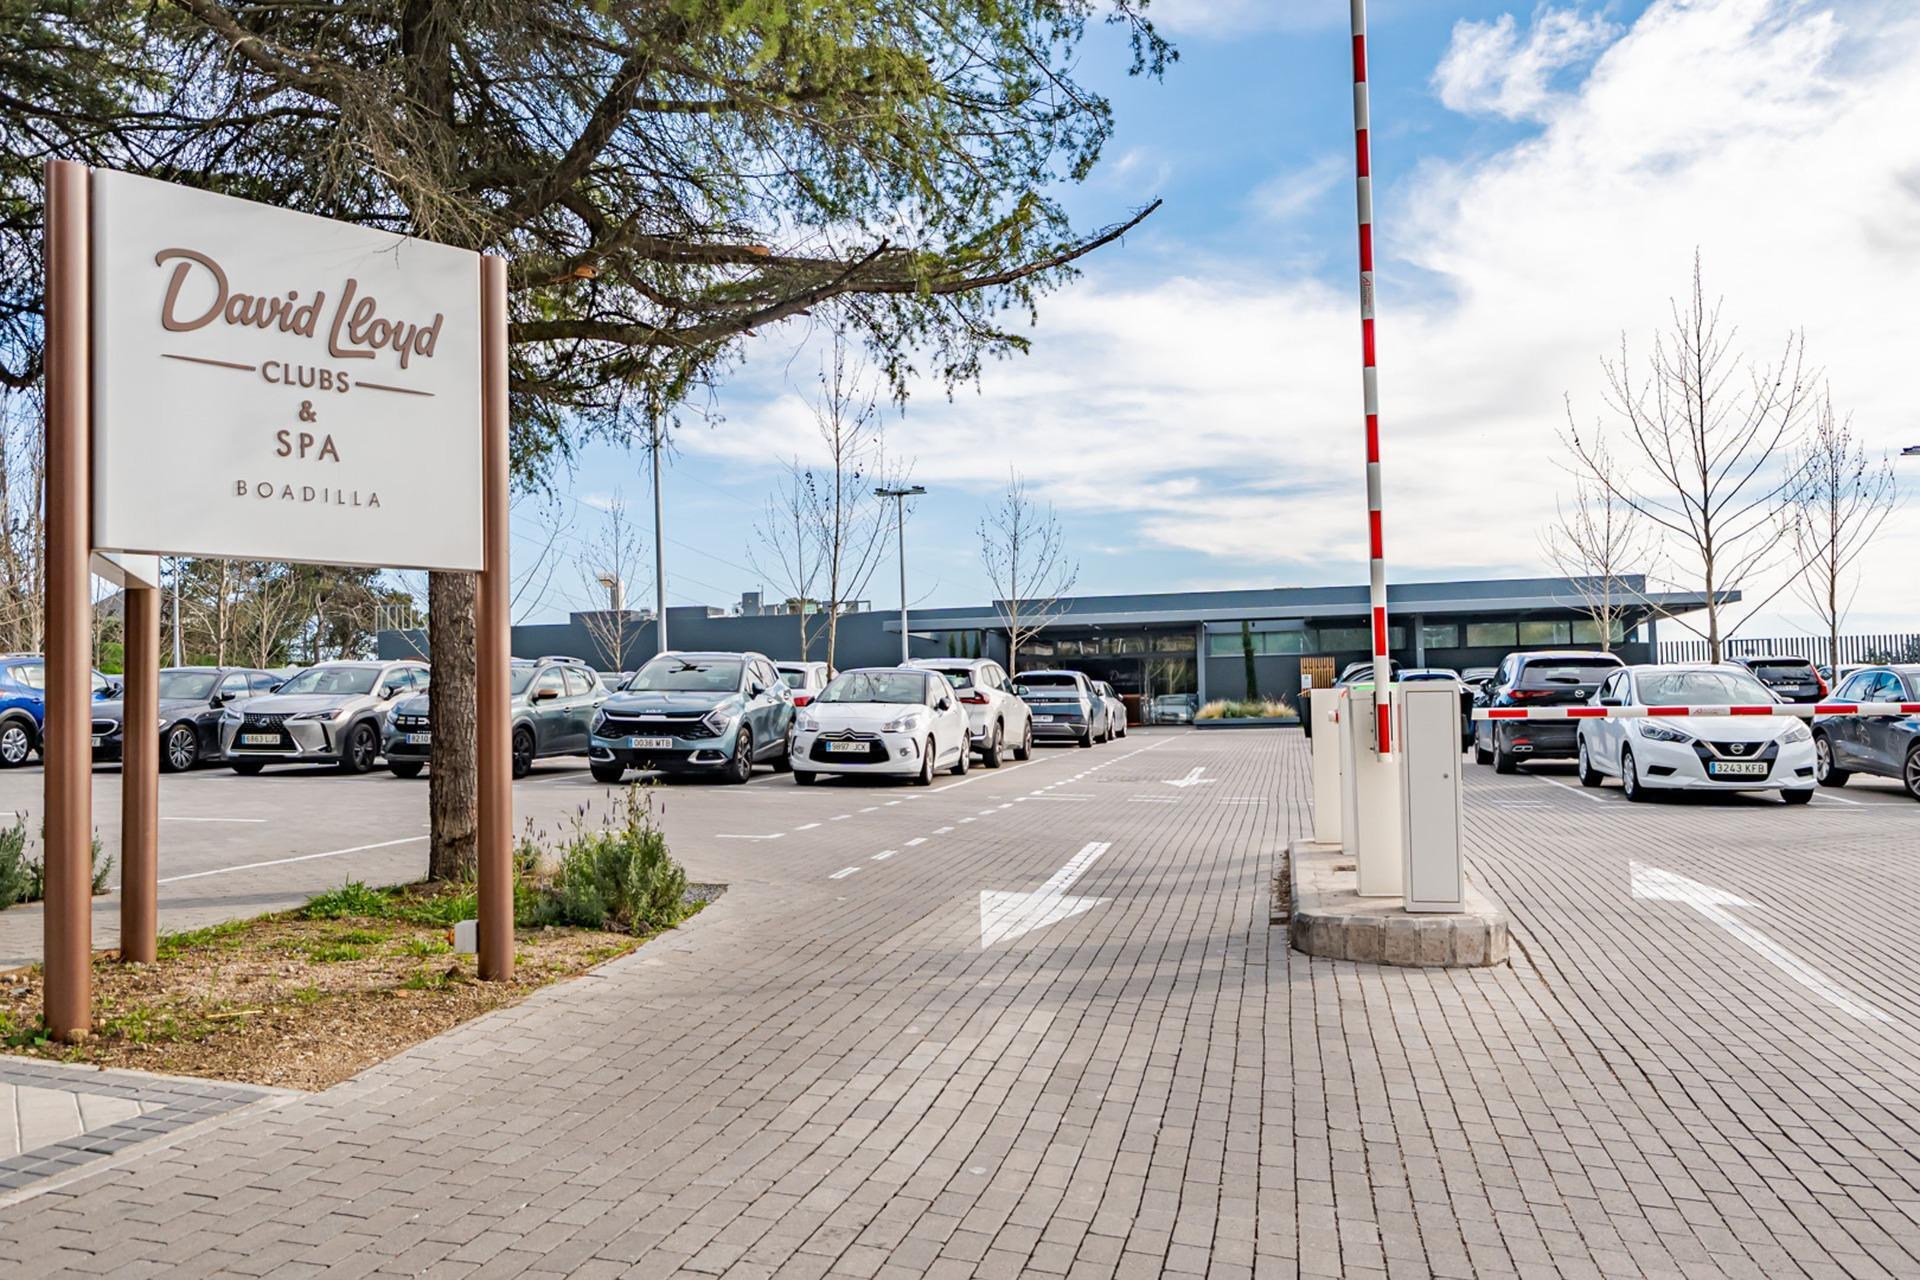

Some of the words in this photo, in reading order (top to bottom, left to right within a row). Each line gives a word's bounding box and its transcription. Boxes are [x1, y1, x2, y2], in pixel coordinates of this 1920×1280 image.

[154, 247, 326, 338] David
[327, 278, 444, 369] Lloyd
[261, 360, 350, 393] CLUBS
[298, 399, 317, 422] &
[275, 429, 341, 463] SPA
[236, 479, 381, 508] BOADILLA
[1716, 763, 1742, 772] 3243
[1745, 764, 1764, 773] KFB
